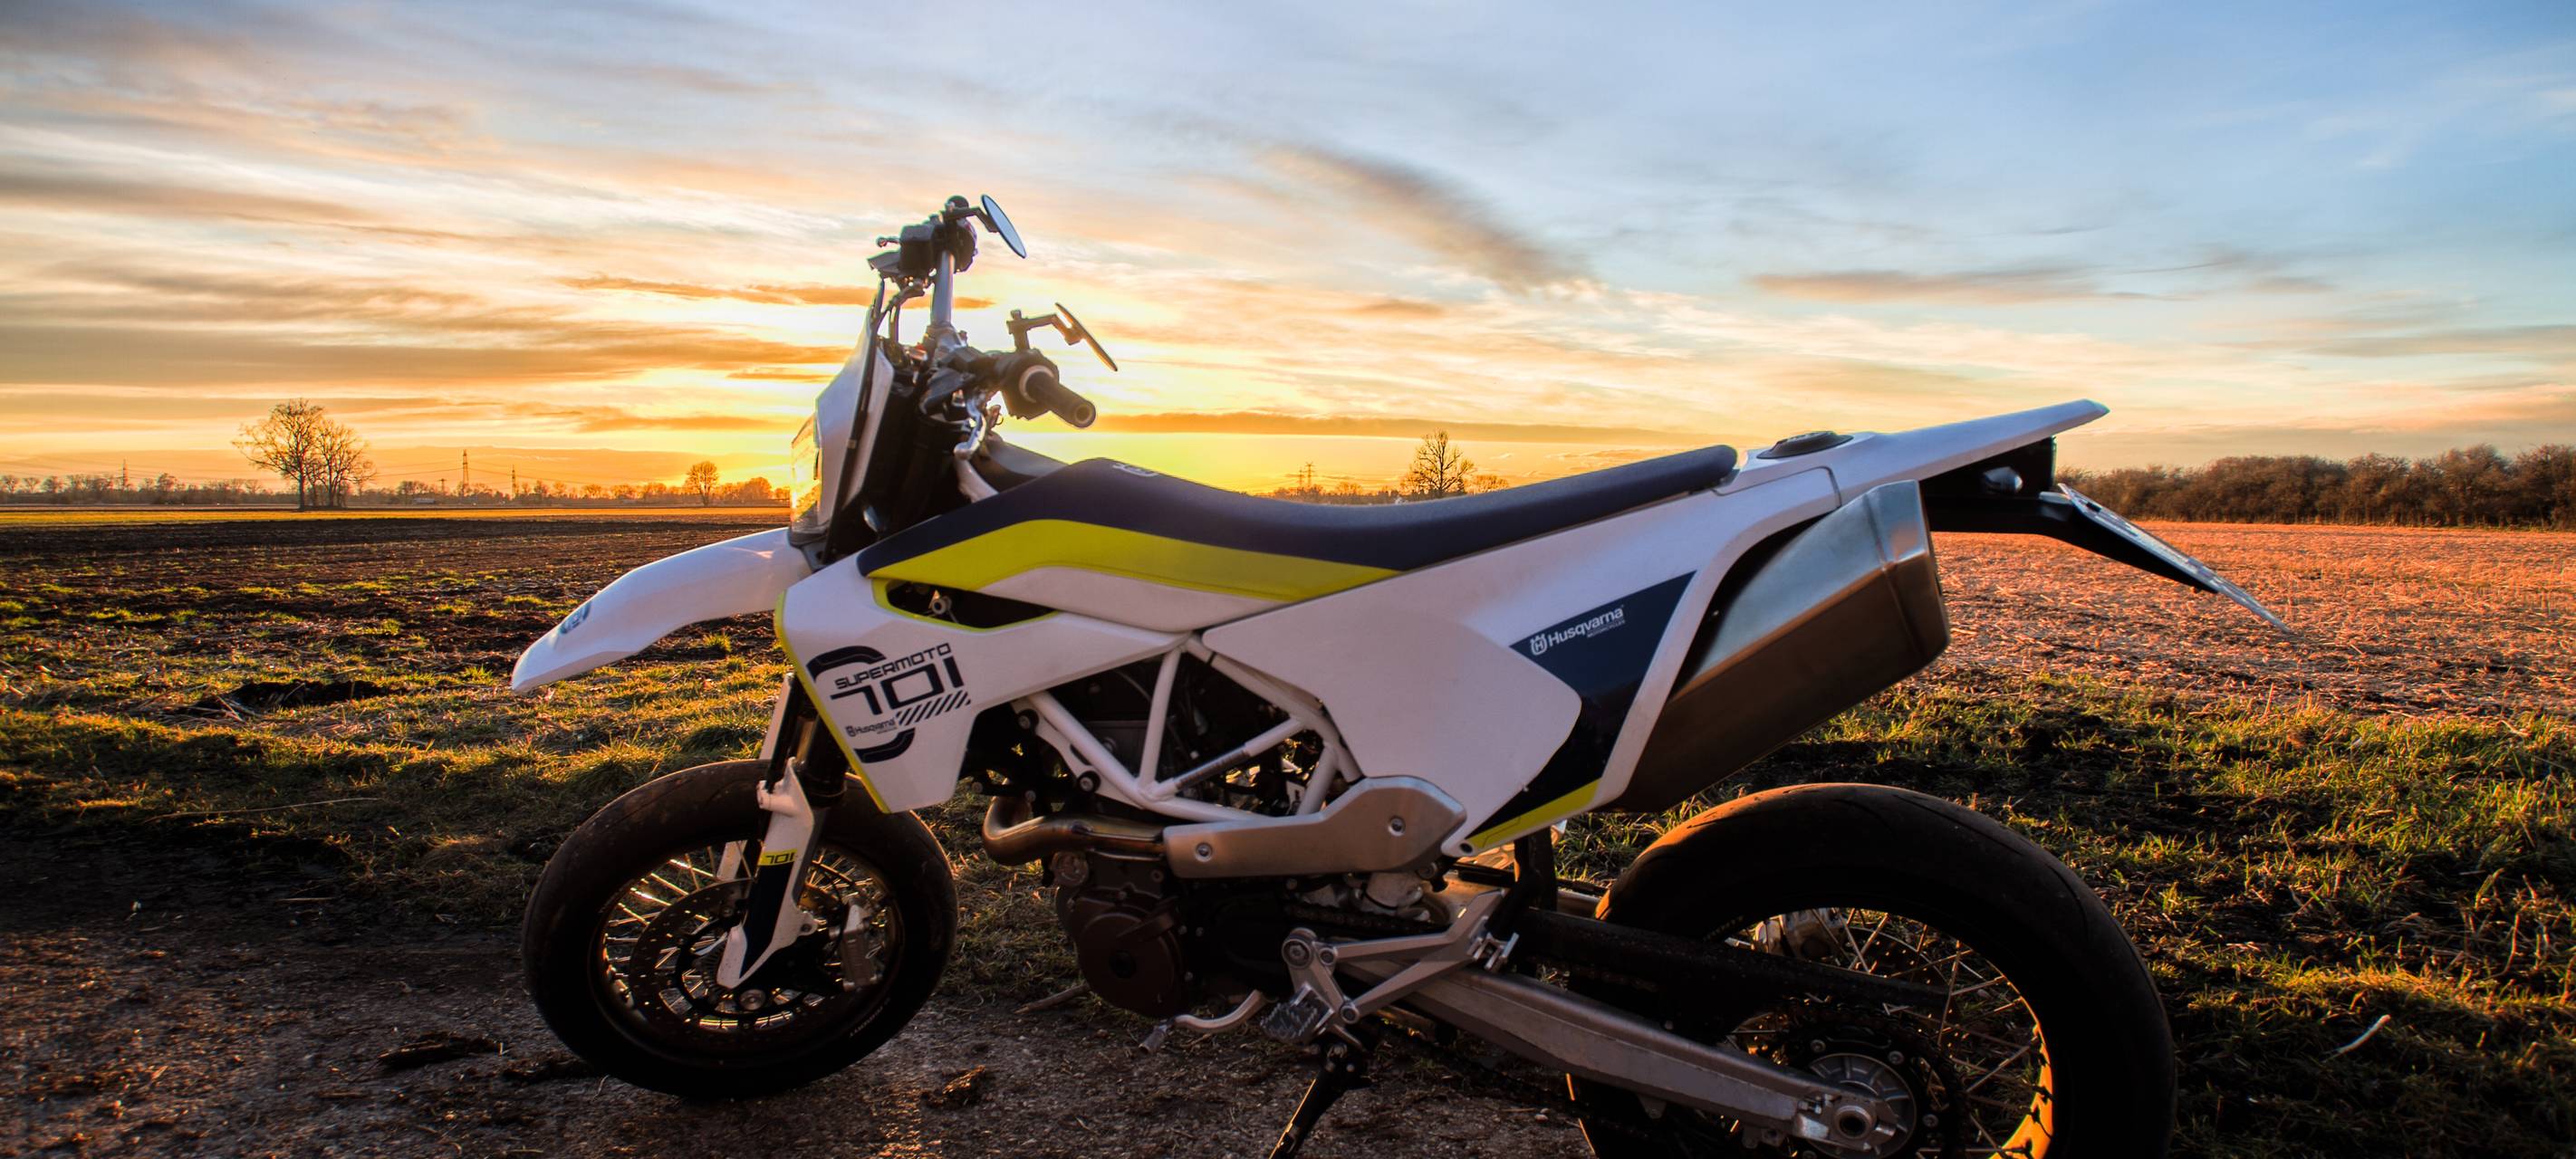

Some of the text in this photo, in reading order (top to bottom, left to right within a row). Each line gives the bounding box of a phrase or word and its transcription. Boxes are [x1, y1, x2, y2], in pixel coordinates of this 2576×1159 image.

[1548, 608, 1623, 647] Husqvarna
[830, 656, 964, 715] 701
[834, 643, 952, 689] SUPERMOTO
[766, 852, 795, 864] 701
